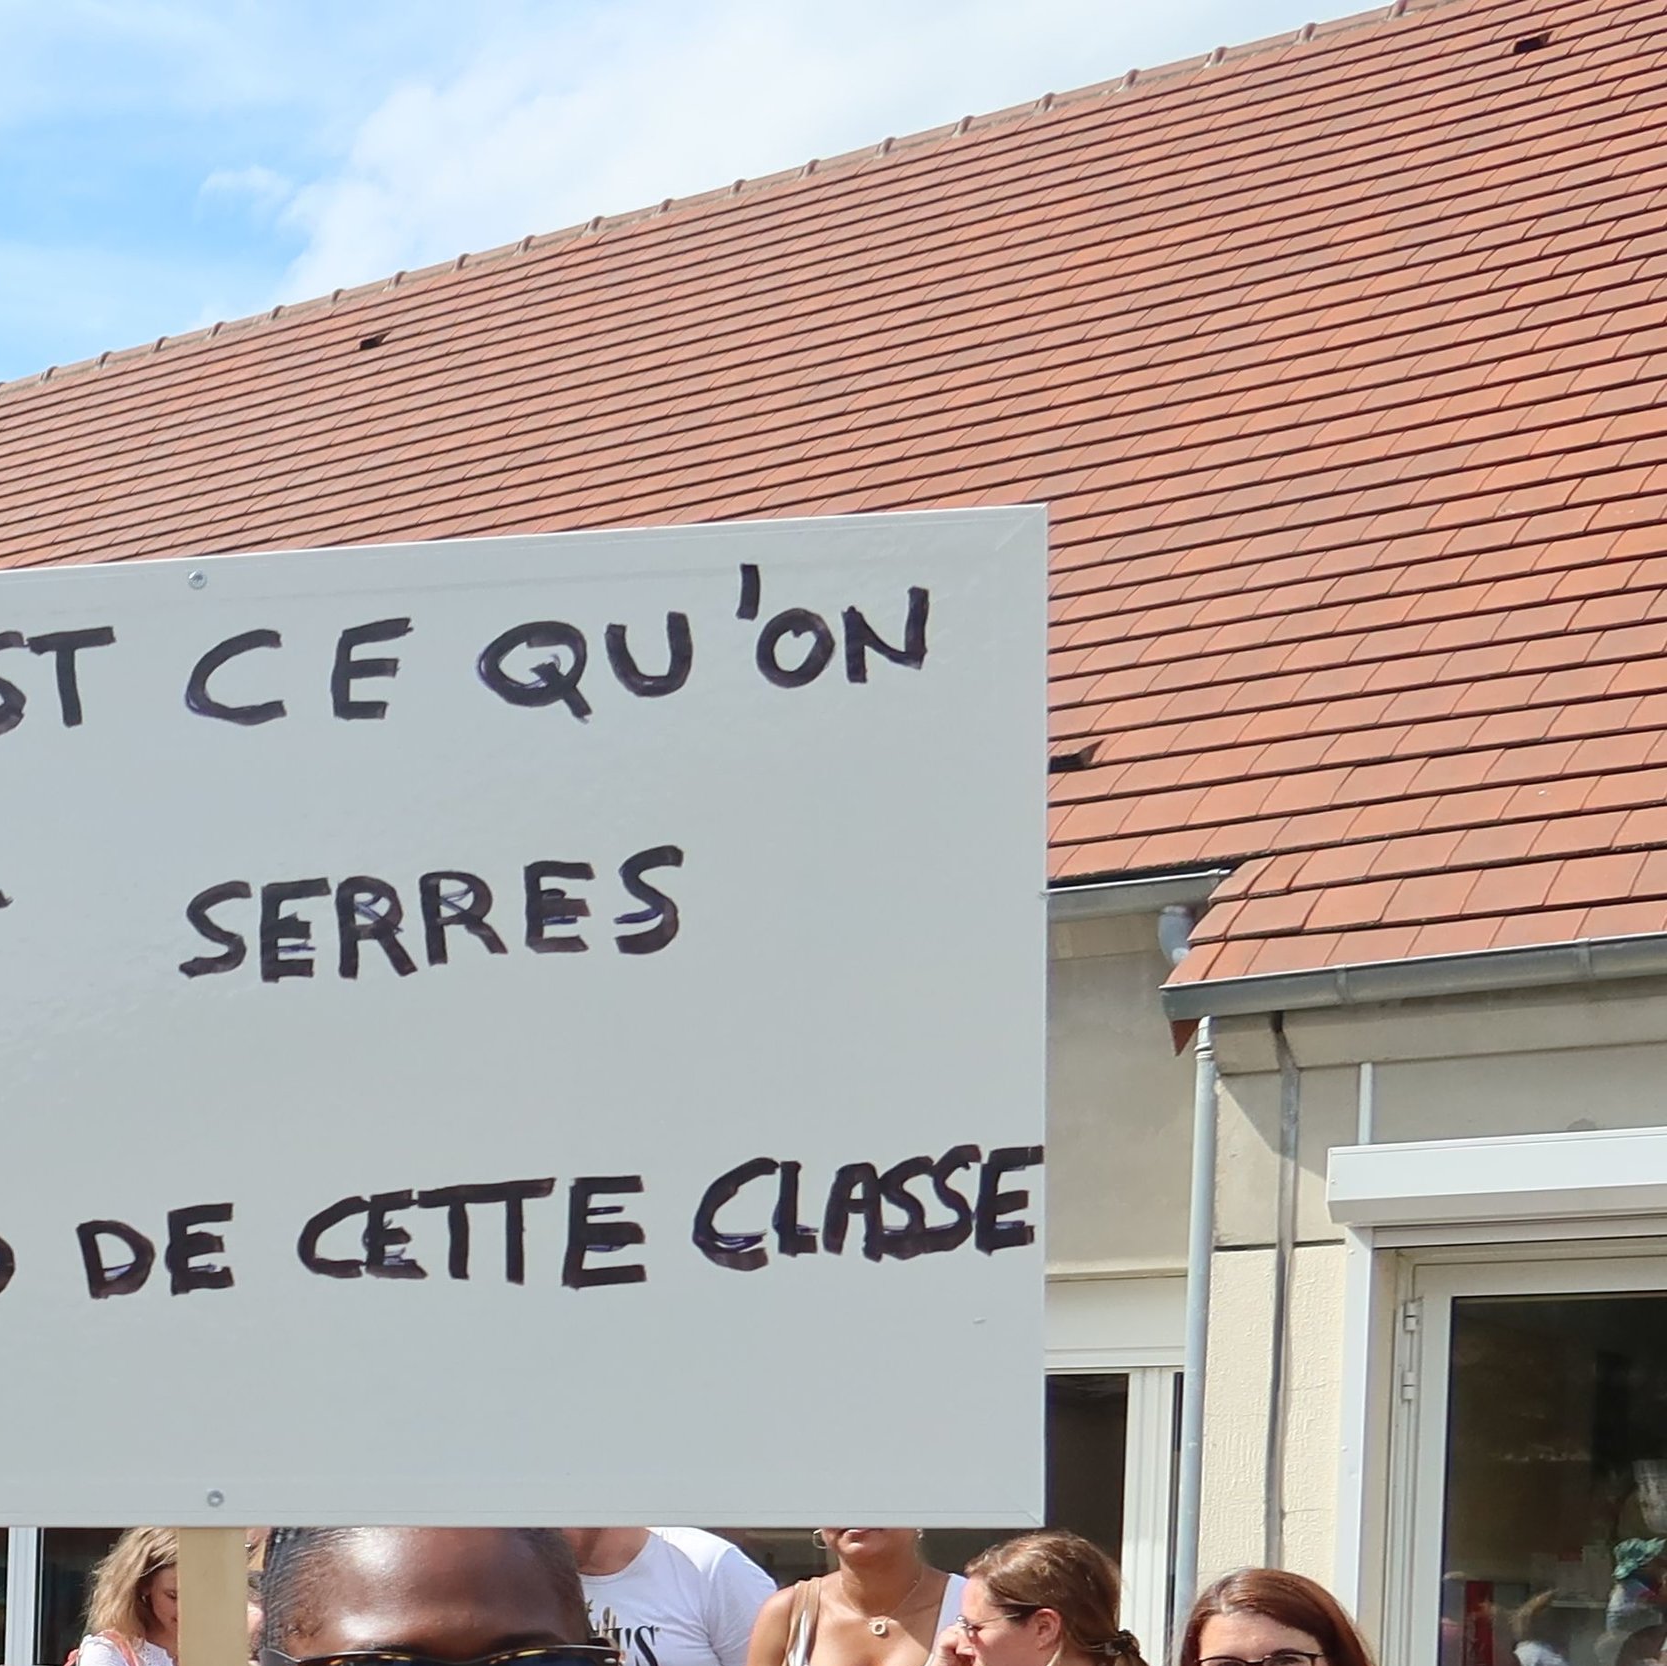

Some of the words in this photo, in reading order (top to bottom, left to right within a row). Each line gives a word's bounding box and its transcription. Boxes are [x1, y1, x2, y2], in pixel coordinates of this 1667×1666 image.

[185, 616, 413, 725] CE
[477, 563, 929, 719] QU'ON
[178, 844, 684, 984] SERRES
[75, 1202, 235, 1300] DE
[296, 1175, 647, 1290] CETTE
[691, 1143, 1044, 1272] CLASSE
